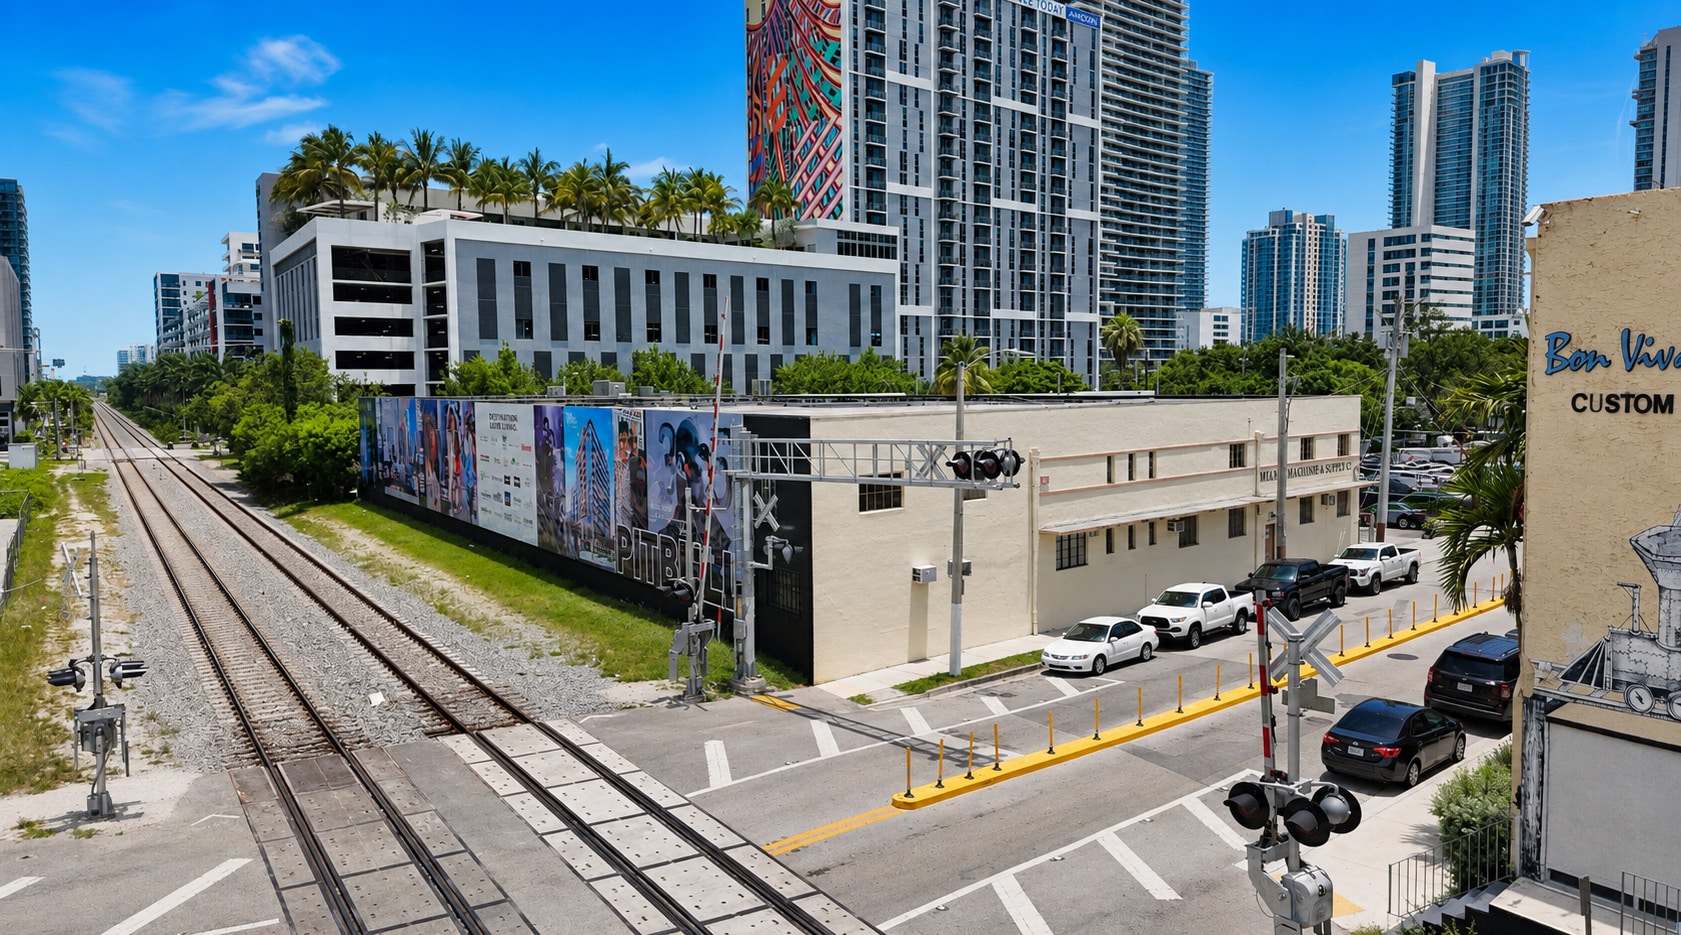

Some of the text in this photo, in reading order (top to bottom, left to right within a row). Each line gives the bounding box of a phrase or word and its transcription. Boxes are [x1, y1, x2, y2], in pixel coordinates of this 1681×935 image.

[1545, 331, 1612, 376] Bon
[1571, 392, 1675, 414] CUSTOM
[1260, 470, 1278, 482] MIAM
